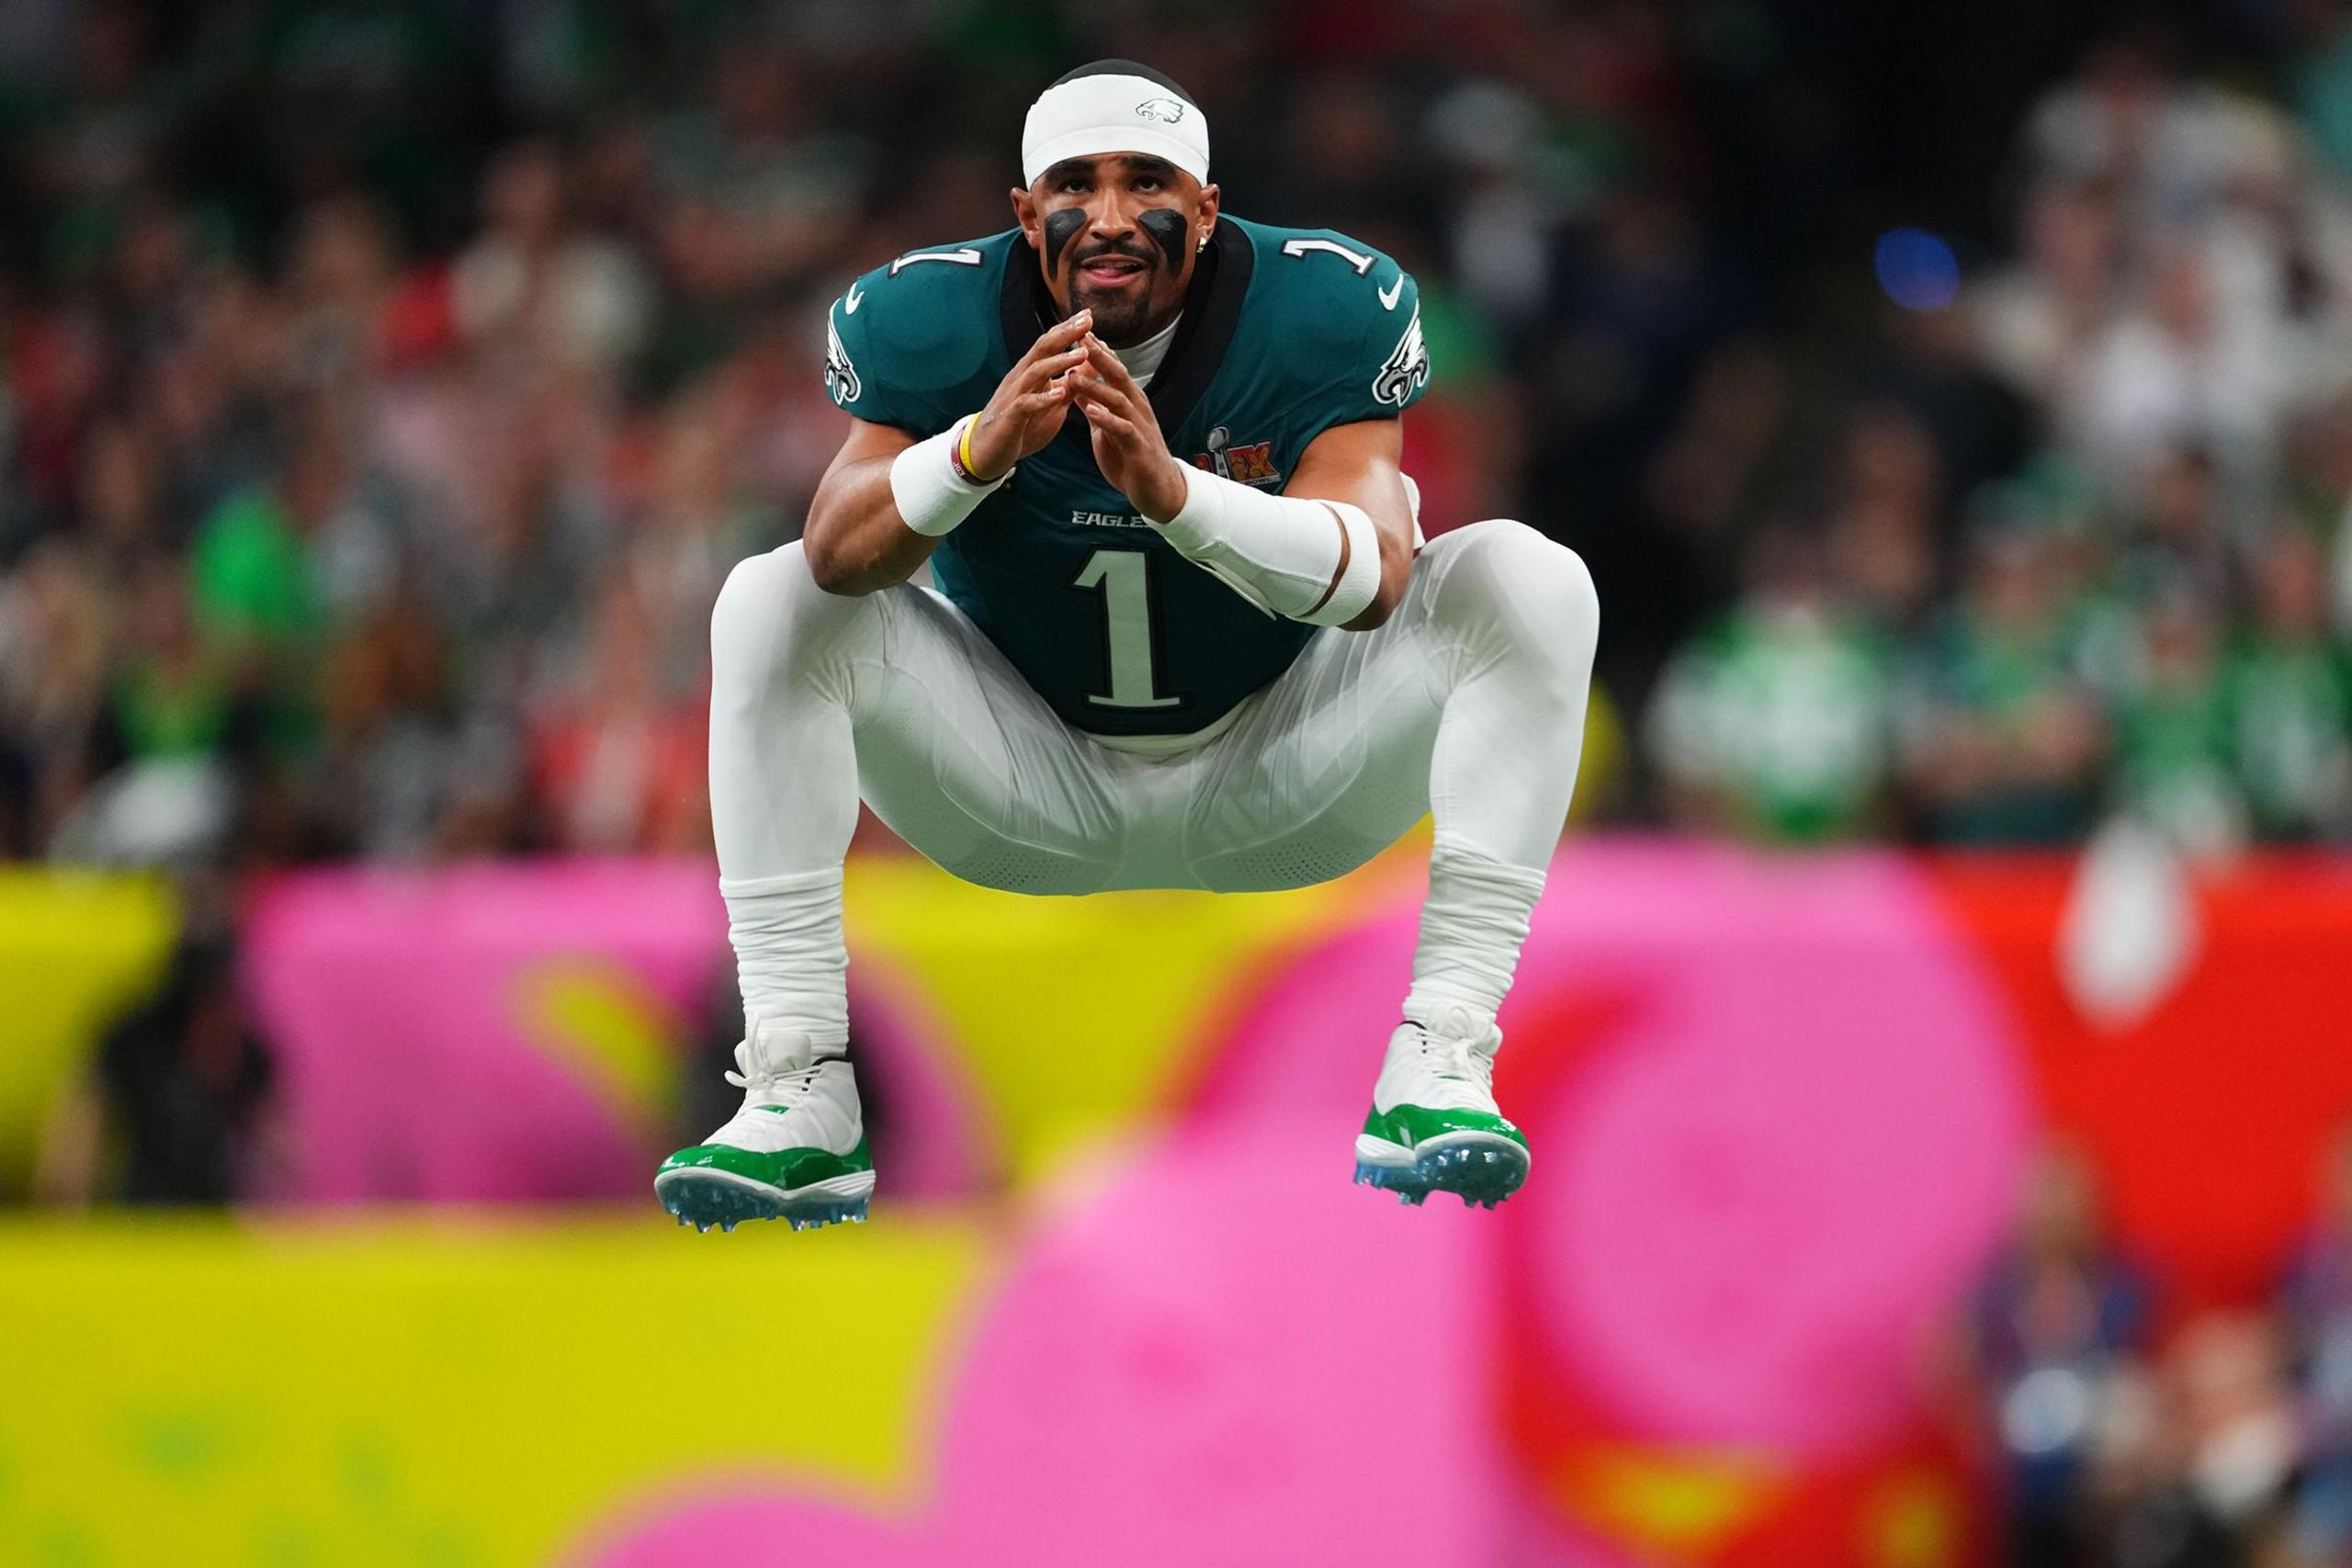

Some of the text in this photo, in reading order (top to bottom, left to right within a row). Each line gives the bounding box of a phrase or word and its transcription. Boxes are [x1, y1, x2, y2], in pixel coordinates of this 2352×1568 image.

[890, 247, 982, 276] 1
[1282, 239, 1375, 275] 1
[1071, 511, 1149, 528] EAGLE
[1072, 549, 1182, 708] 1
